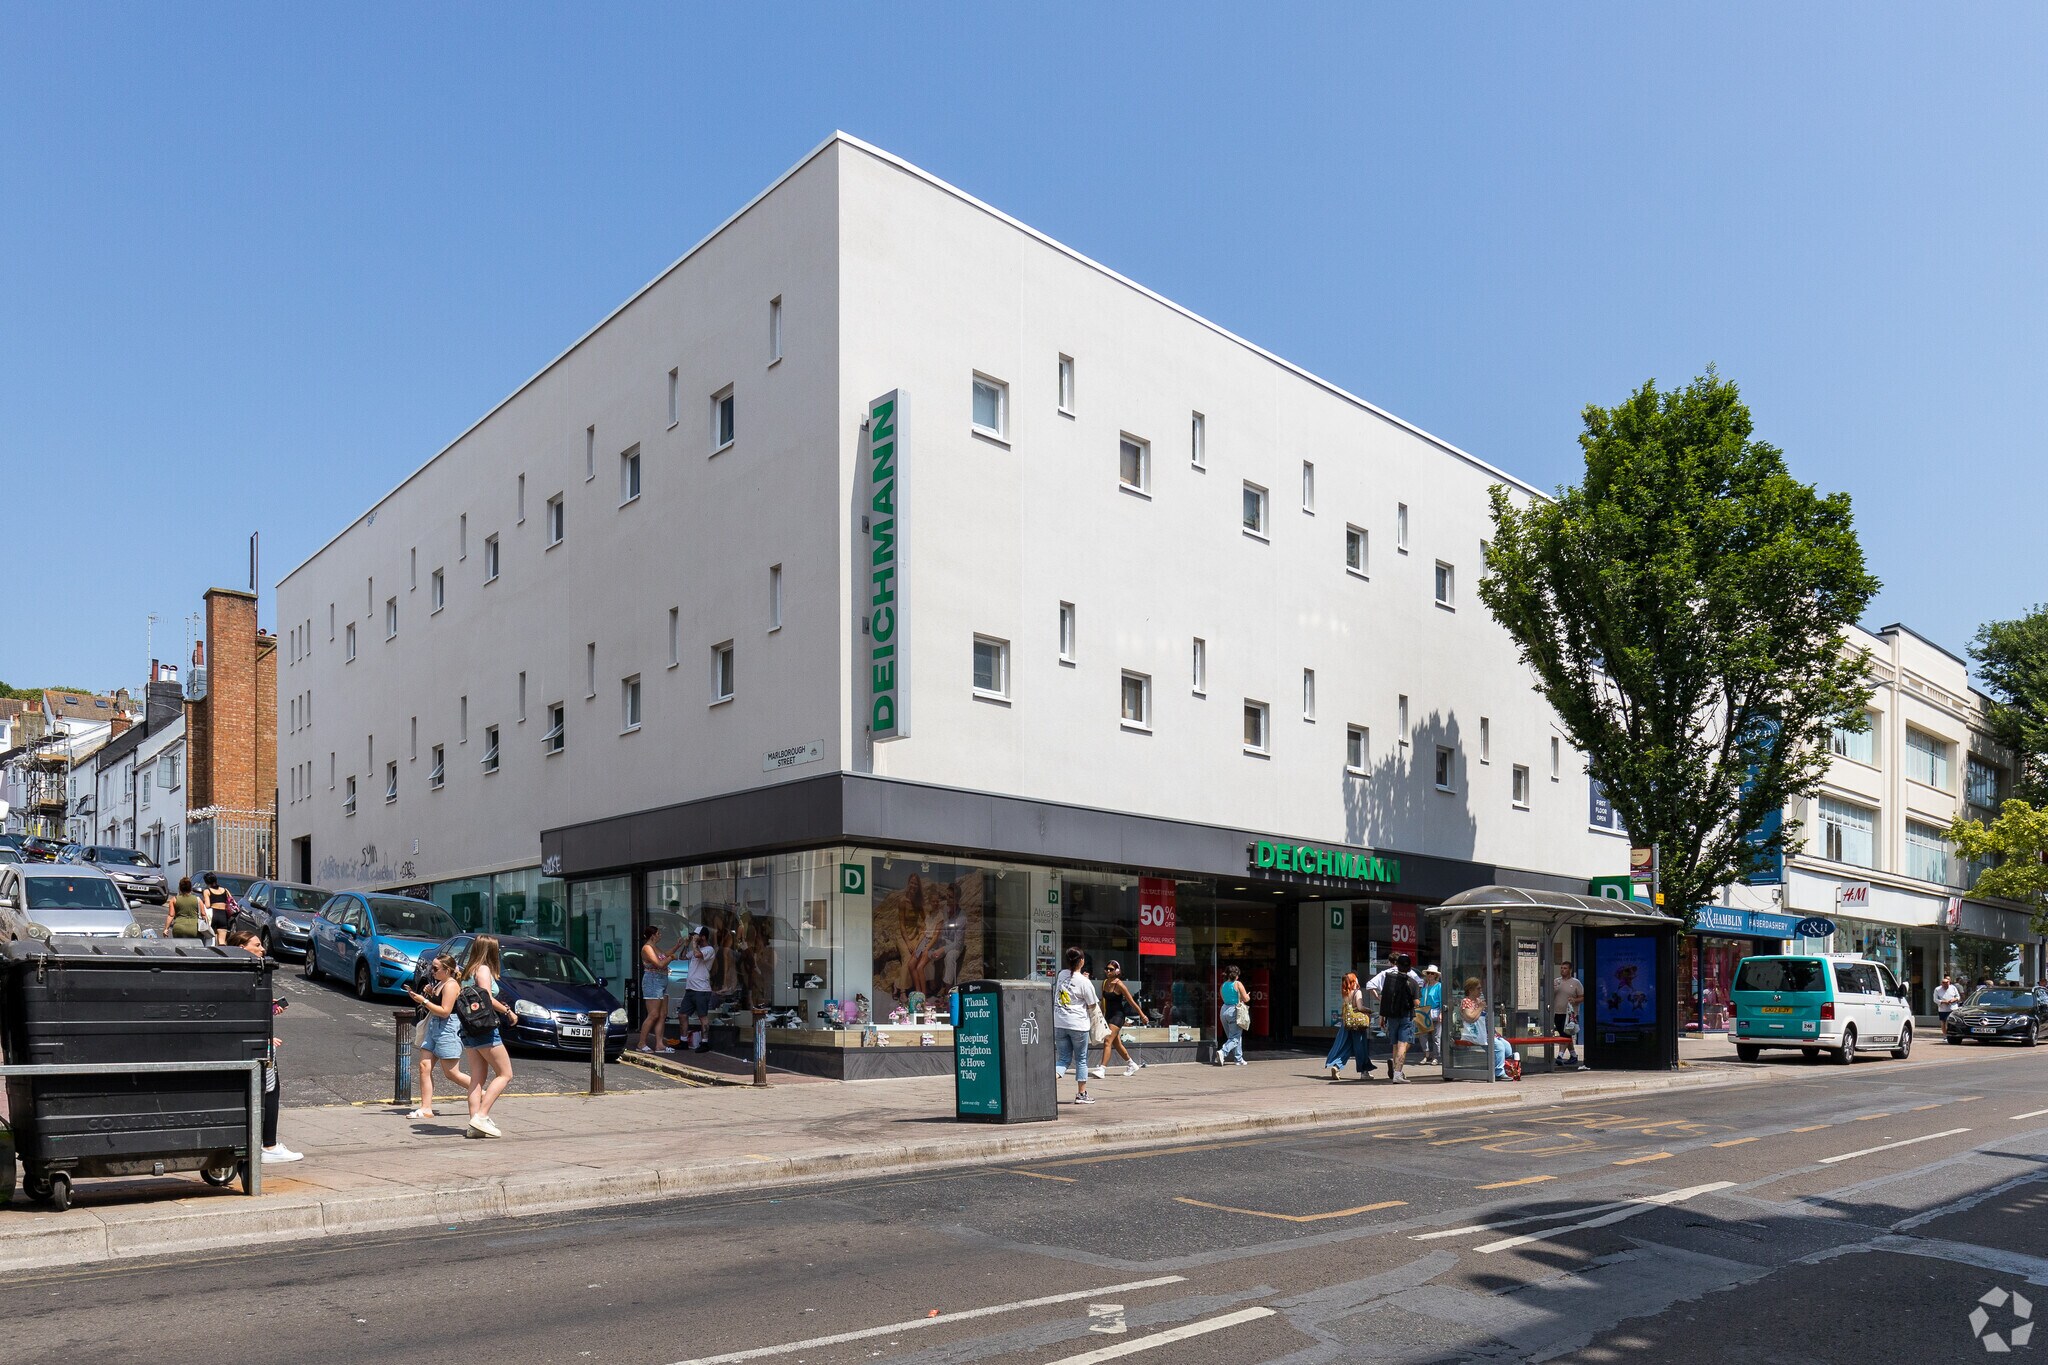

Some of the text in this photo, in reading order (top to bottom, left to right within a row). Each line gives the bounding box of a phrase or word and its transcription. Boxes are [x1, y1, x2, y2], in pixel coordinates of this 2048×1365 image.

[872, 399, 894, 731] DEICHMANN
[767, 744, 806, 761] MARLBOROUGH
[777, 755, 796, 767] STREET
[1257, 840, 1401, 884] DEICHMANN
[844, 868, 862, 889] D
[662, 884, 679, 901] D
[1049, 891, 1057, 902] D
[1843, 887, 1866, 901] H&M
[463, 906, 471, 923] D
[509, 904, 517, 921] D
[1032, 907, 1059, 920] Always
[1140, 904, 1175, 926] 50%
[1333, 910, 1343, 926] D
[1713, 912, 1743, 927] HAMBLIN
[1140, 935, 1161, 943] ORIGINAL
[605, 945, 612, 959] D
[964, 997, 988, 1007] Thank
[965, 1008, 990, 1020] you for
[571, 1028, 580, 1036] N9
[959, 1033, 988, 1044] Keeping
[959, 1045, 991, 1057] Brighton
[960, 1058, 985, 1067] & Hove
[960, 1070, 977, 1081] Tidy
[86, 1114, 226, 1131] CONTINENTAL
[1521, 1112, 1741, 1138] BUS
